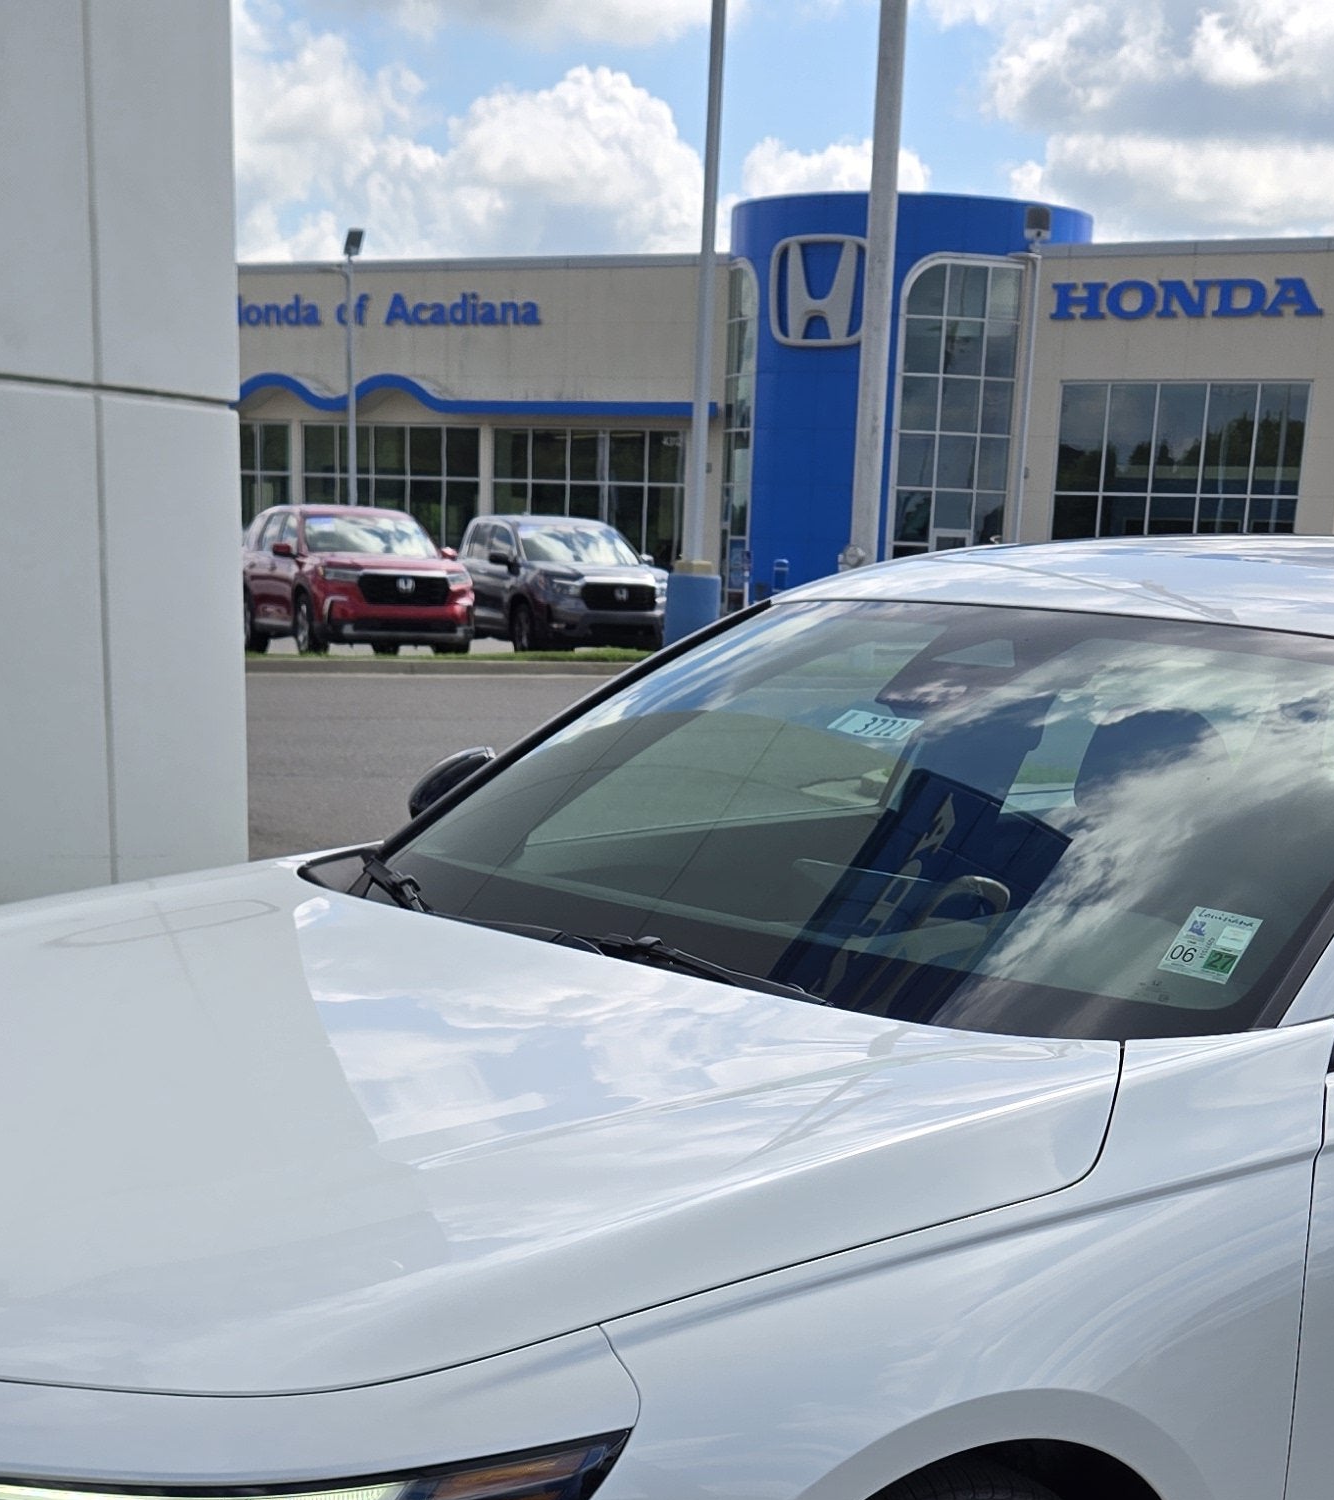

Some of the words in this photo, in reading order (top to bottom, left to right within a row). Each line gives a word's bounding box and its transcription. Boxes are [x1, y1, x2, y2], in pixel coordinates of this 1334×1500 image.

[1050, 277, 1324, 320] HONDA
[238, 293, 321, 327] onda
[384, 292, 543, 326] Acadiana
[1198, 908, 1255, 928] Louisiana
[1169, 944, 1198, 963] 06
[1208, 952, 1236, 971] 27
